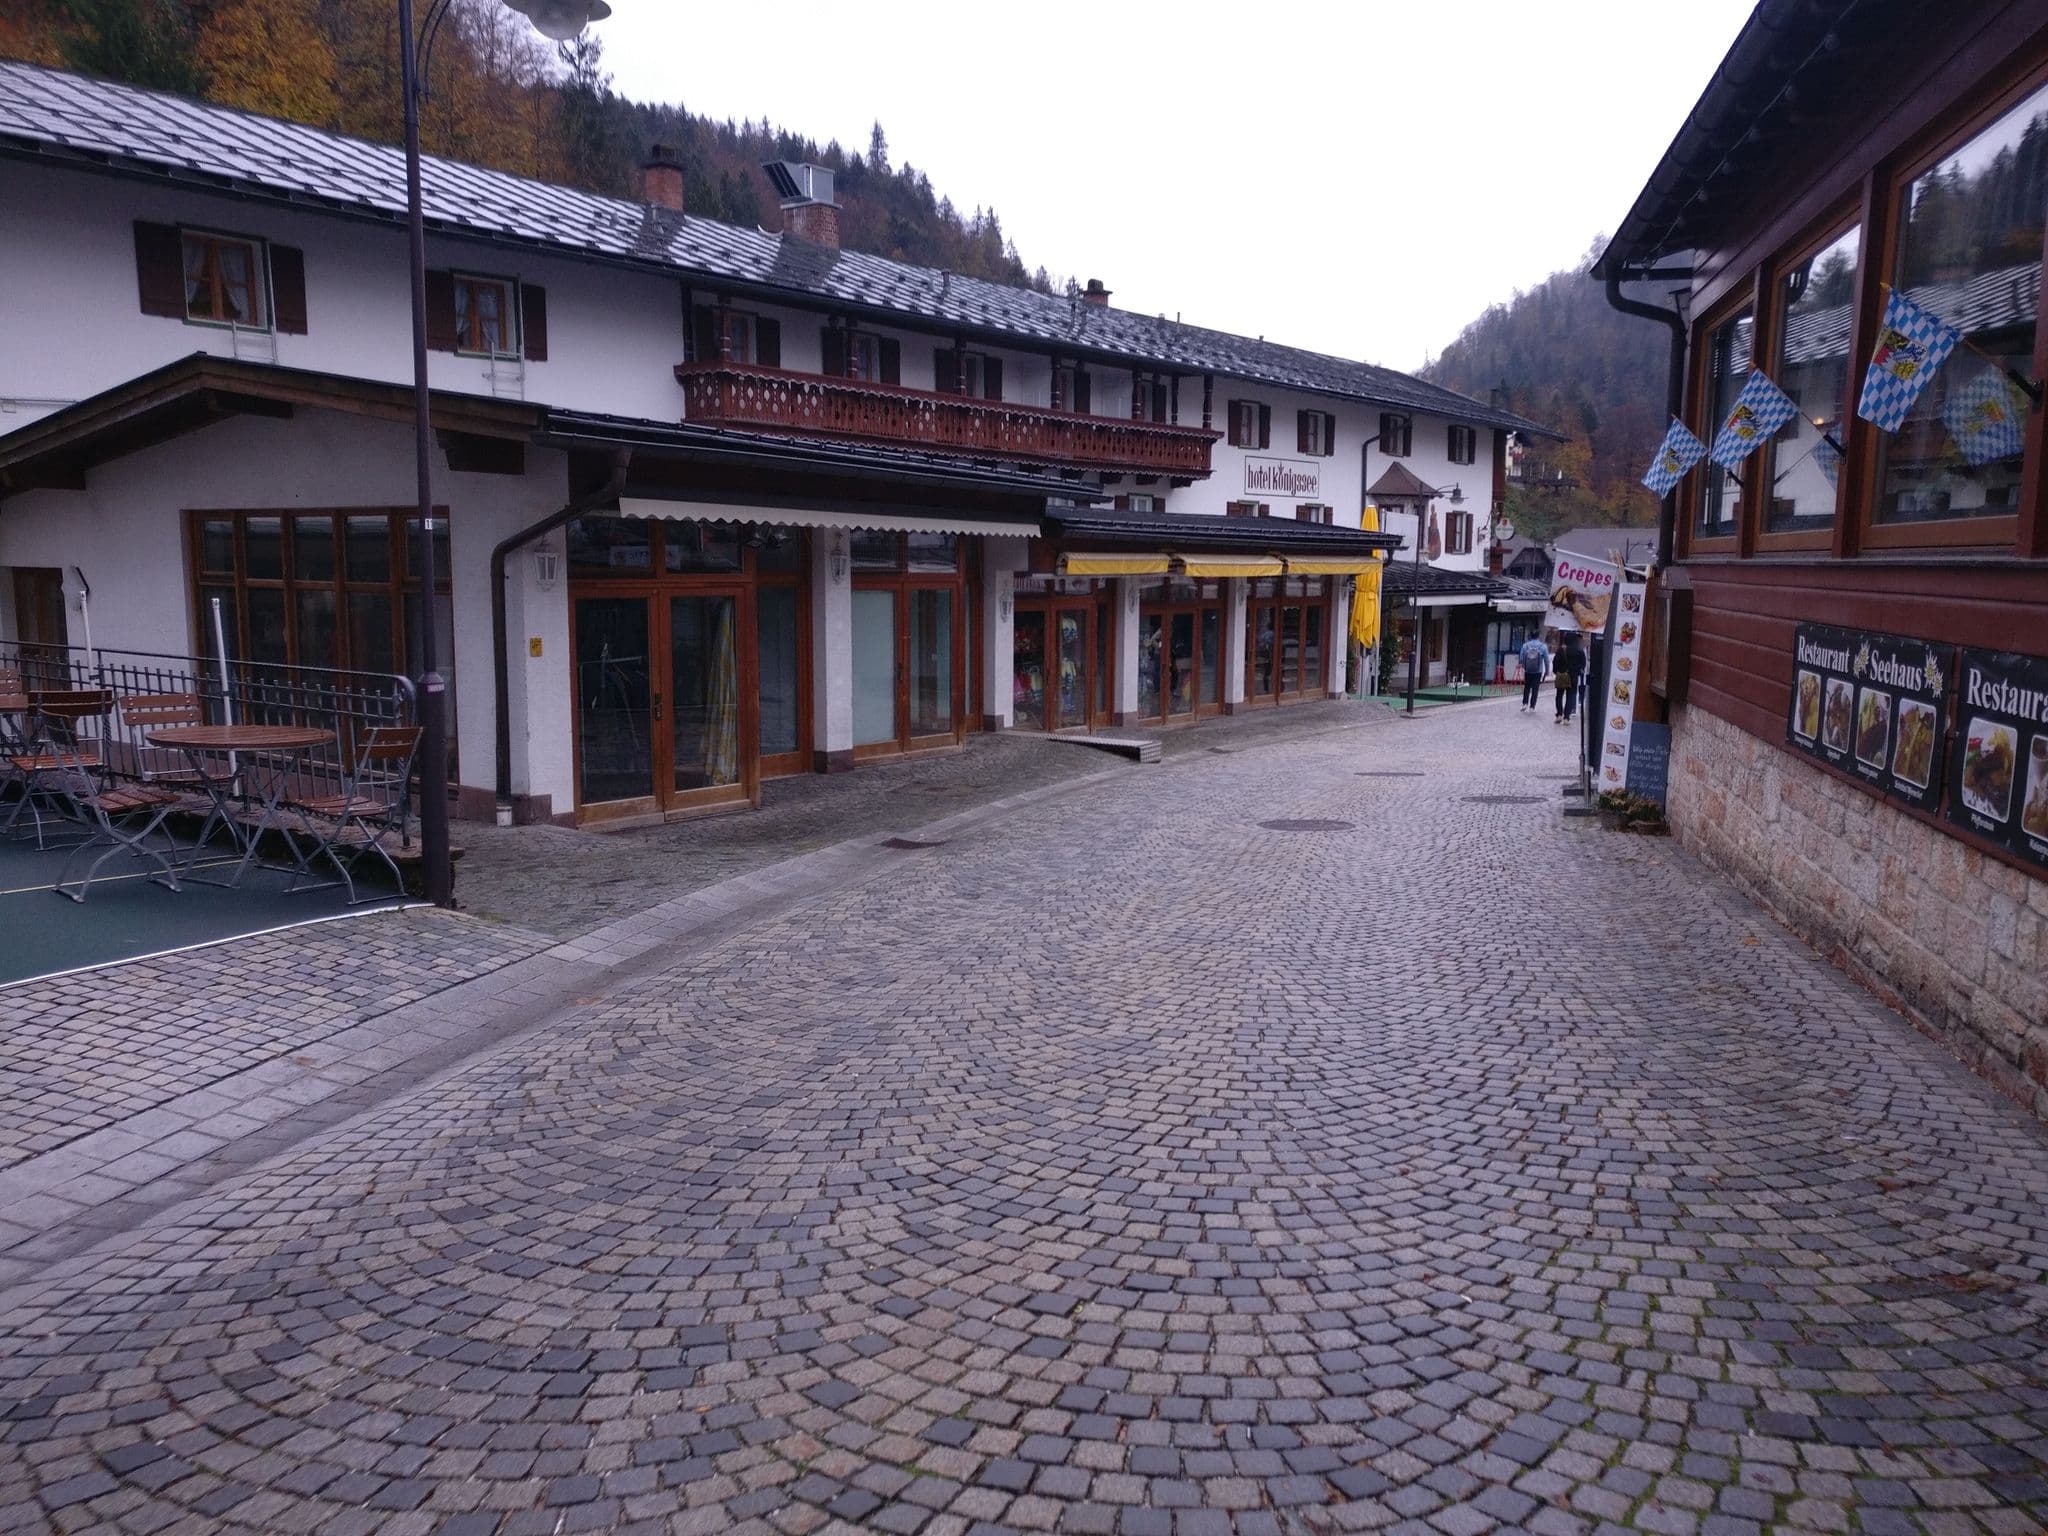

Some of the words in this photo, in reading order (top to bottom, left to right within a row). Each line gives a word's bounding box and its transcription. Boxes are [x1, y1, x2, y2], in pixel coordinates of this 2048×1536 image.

[1247, 464, 1271, 489] hotel
[1272, 464, 1317, 496] königssee
[1558, 561, 1612, 588] Crepes
[1798, 635, 1850, 674] Restaurant
[1870, 649, 1923, 692] Seehaus
